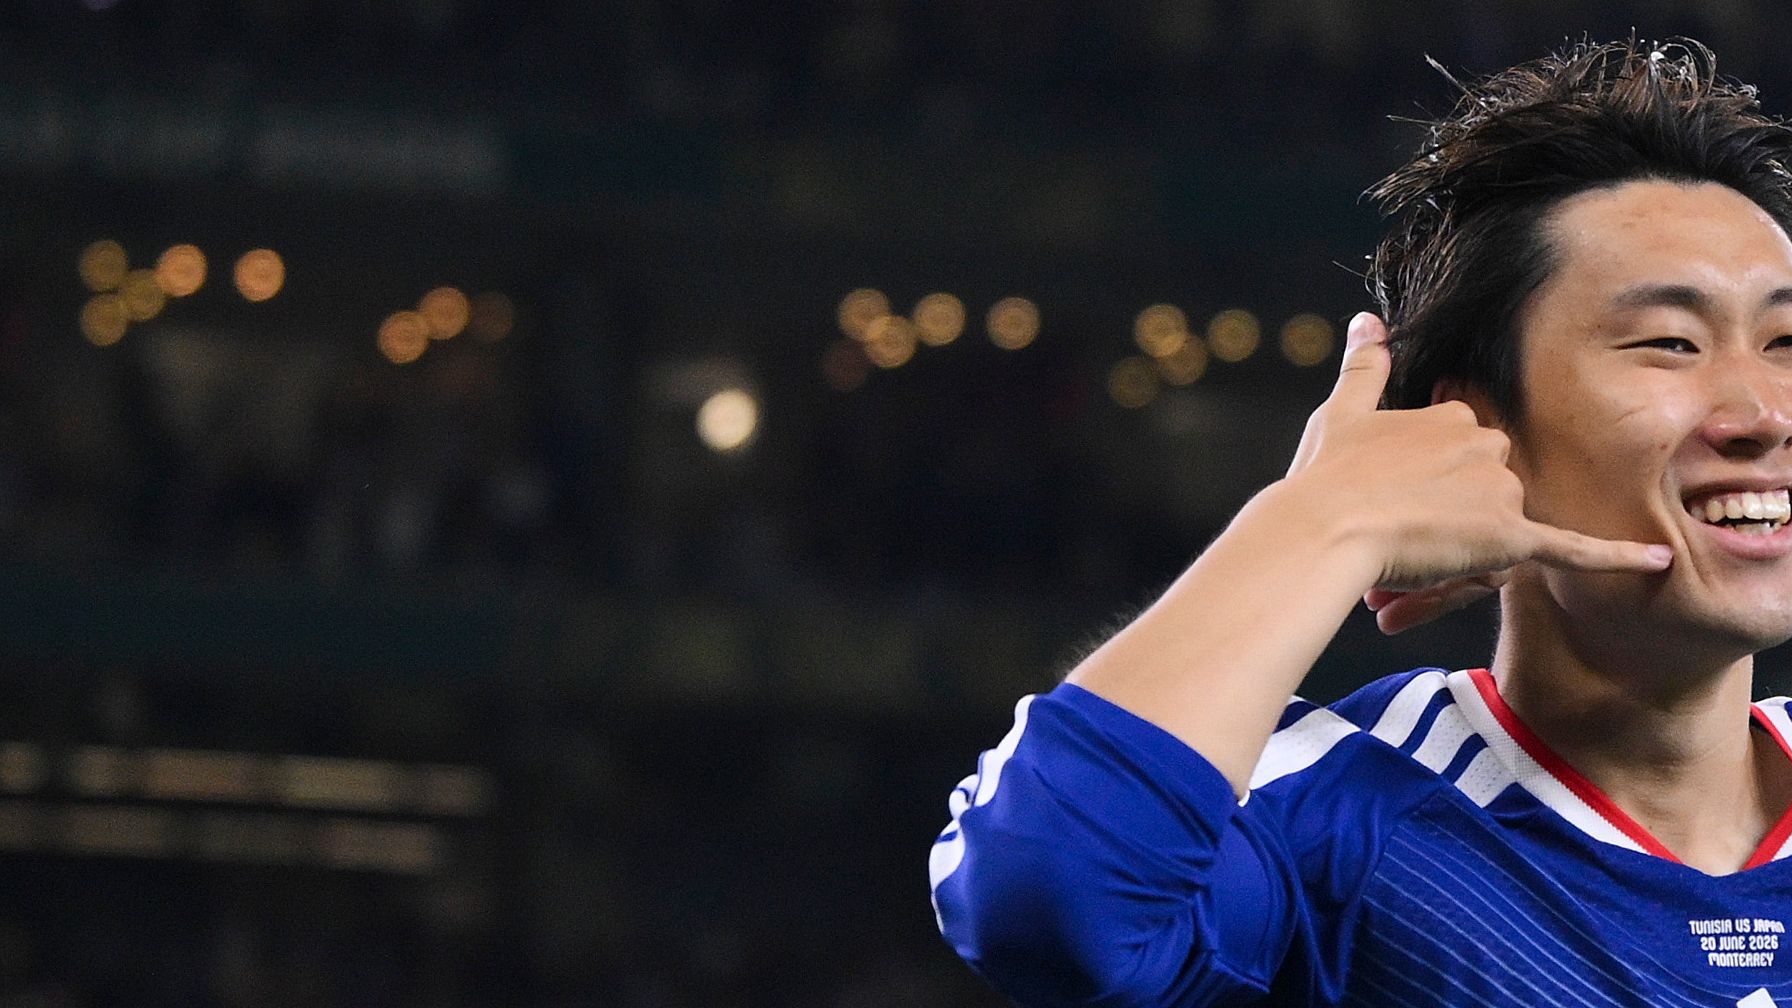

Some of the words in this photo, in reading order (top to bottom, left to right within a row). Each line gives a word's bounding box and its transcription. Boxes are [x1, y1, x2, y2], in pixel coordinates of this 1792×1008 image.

[1688, 919, 1733, 935] TUNISIA
[1700, 936, 1717, 951] 20
[1718, 935, 1747, 951] JUNE
[1748, 934, 1779, 950] 2026
[1707, 952, 1774, 968] MONTERREY
